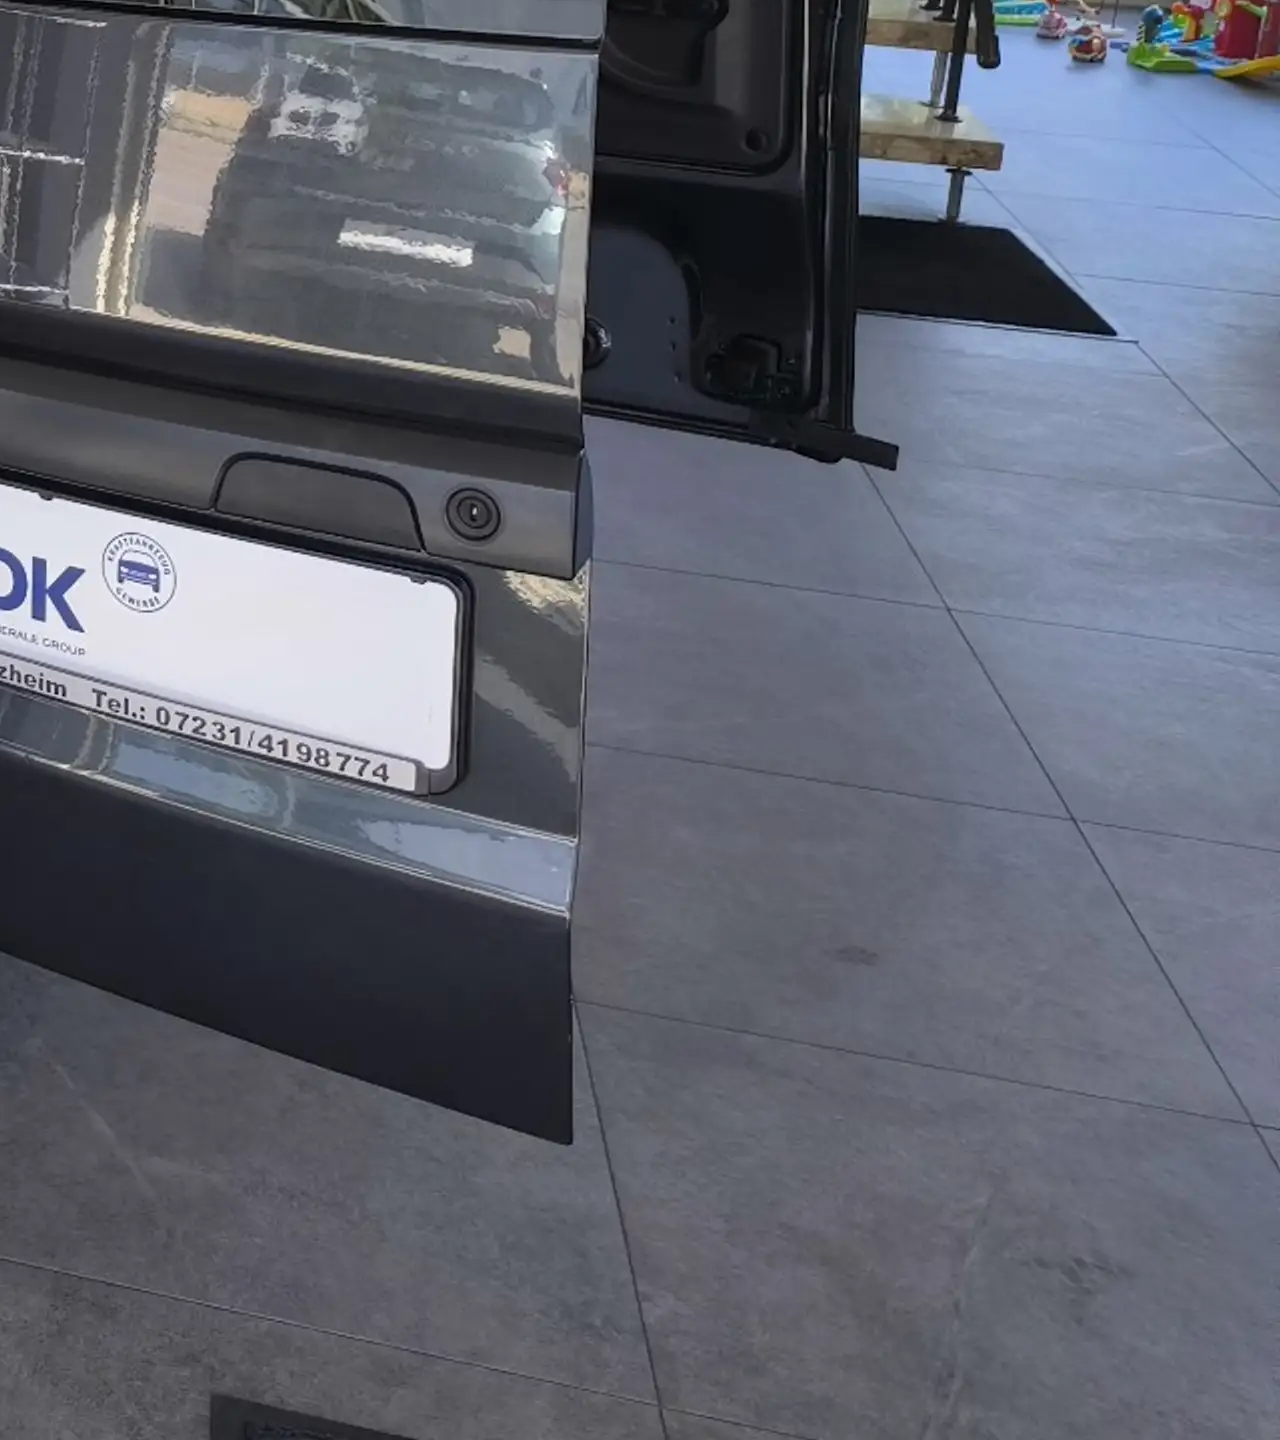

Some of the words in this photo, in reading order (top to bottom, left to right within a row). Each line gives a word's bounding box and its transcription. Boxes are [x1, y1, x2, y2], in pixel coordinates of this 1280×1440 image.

[41, 637, 86, 656] GROUP
[91, 687, 146, 721] Tel.:
[155, 705, 390, 784] 07231/4198774
